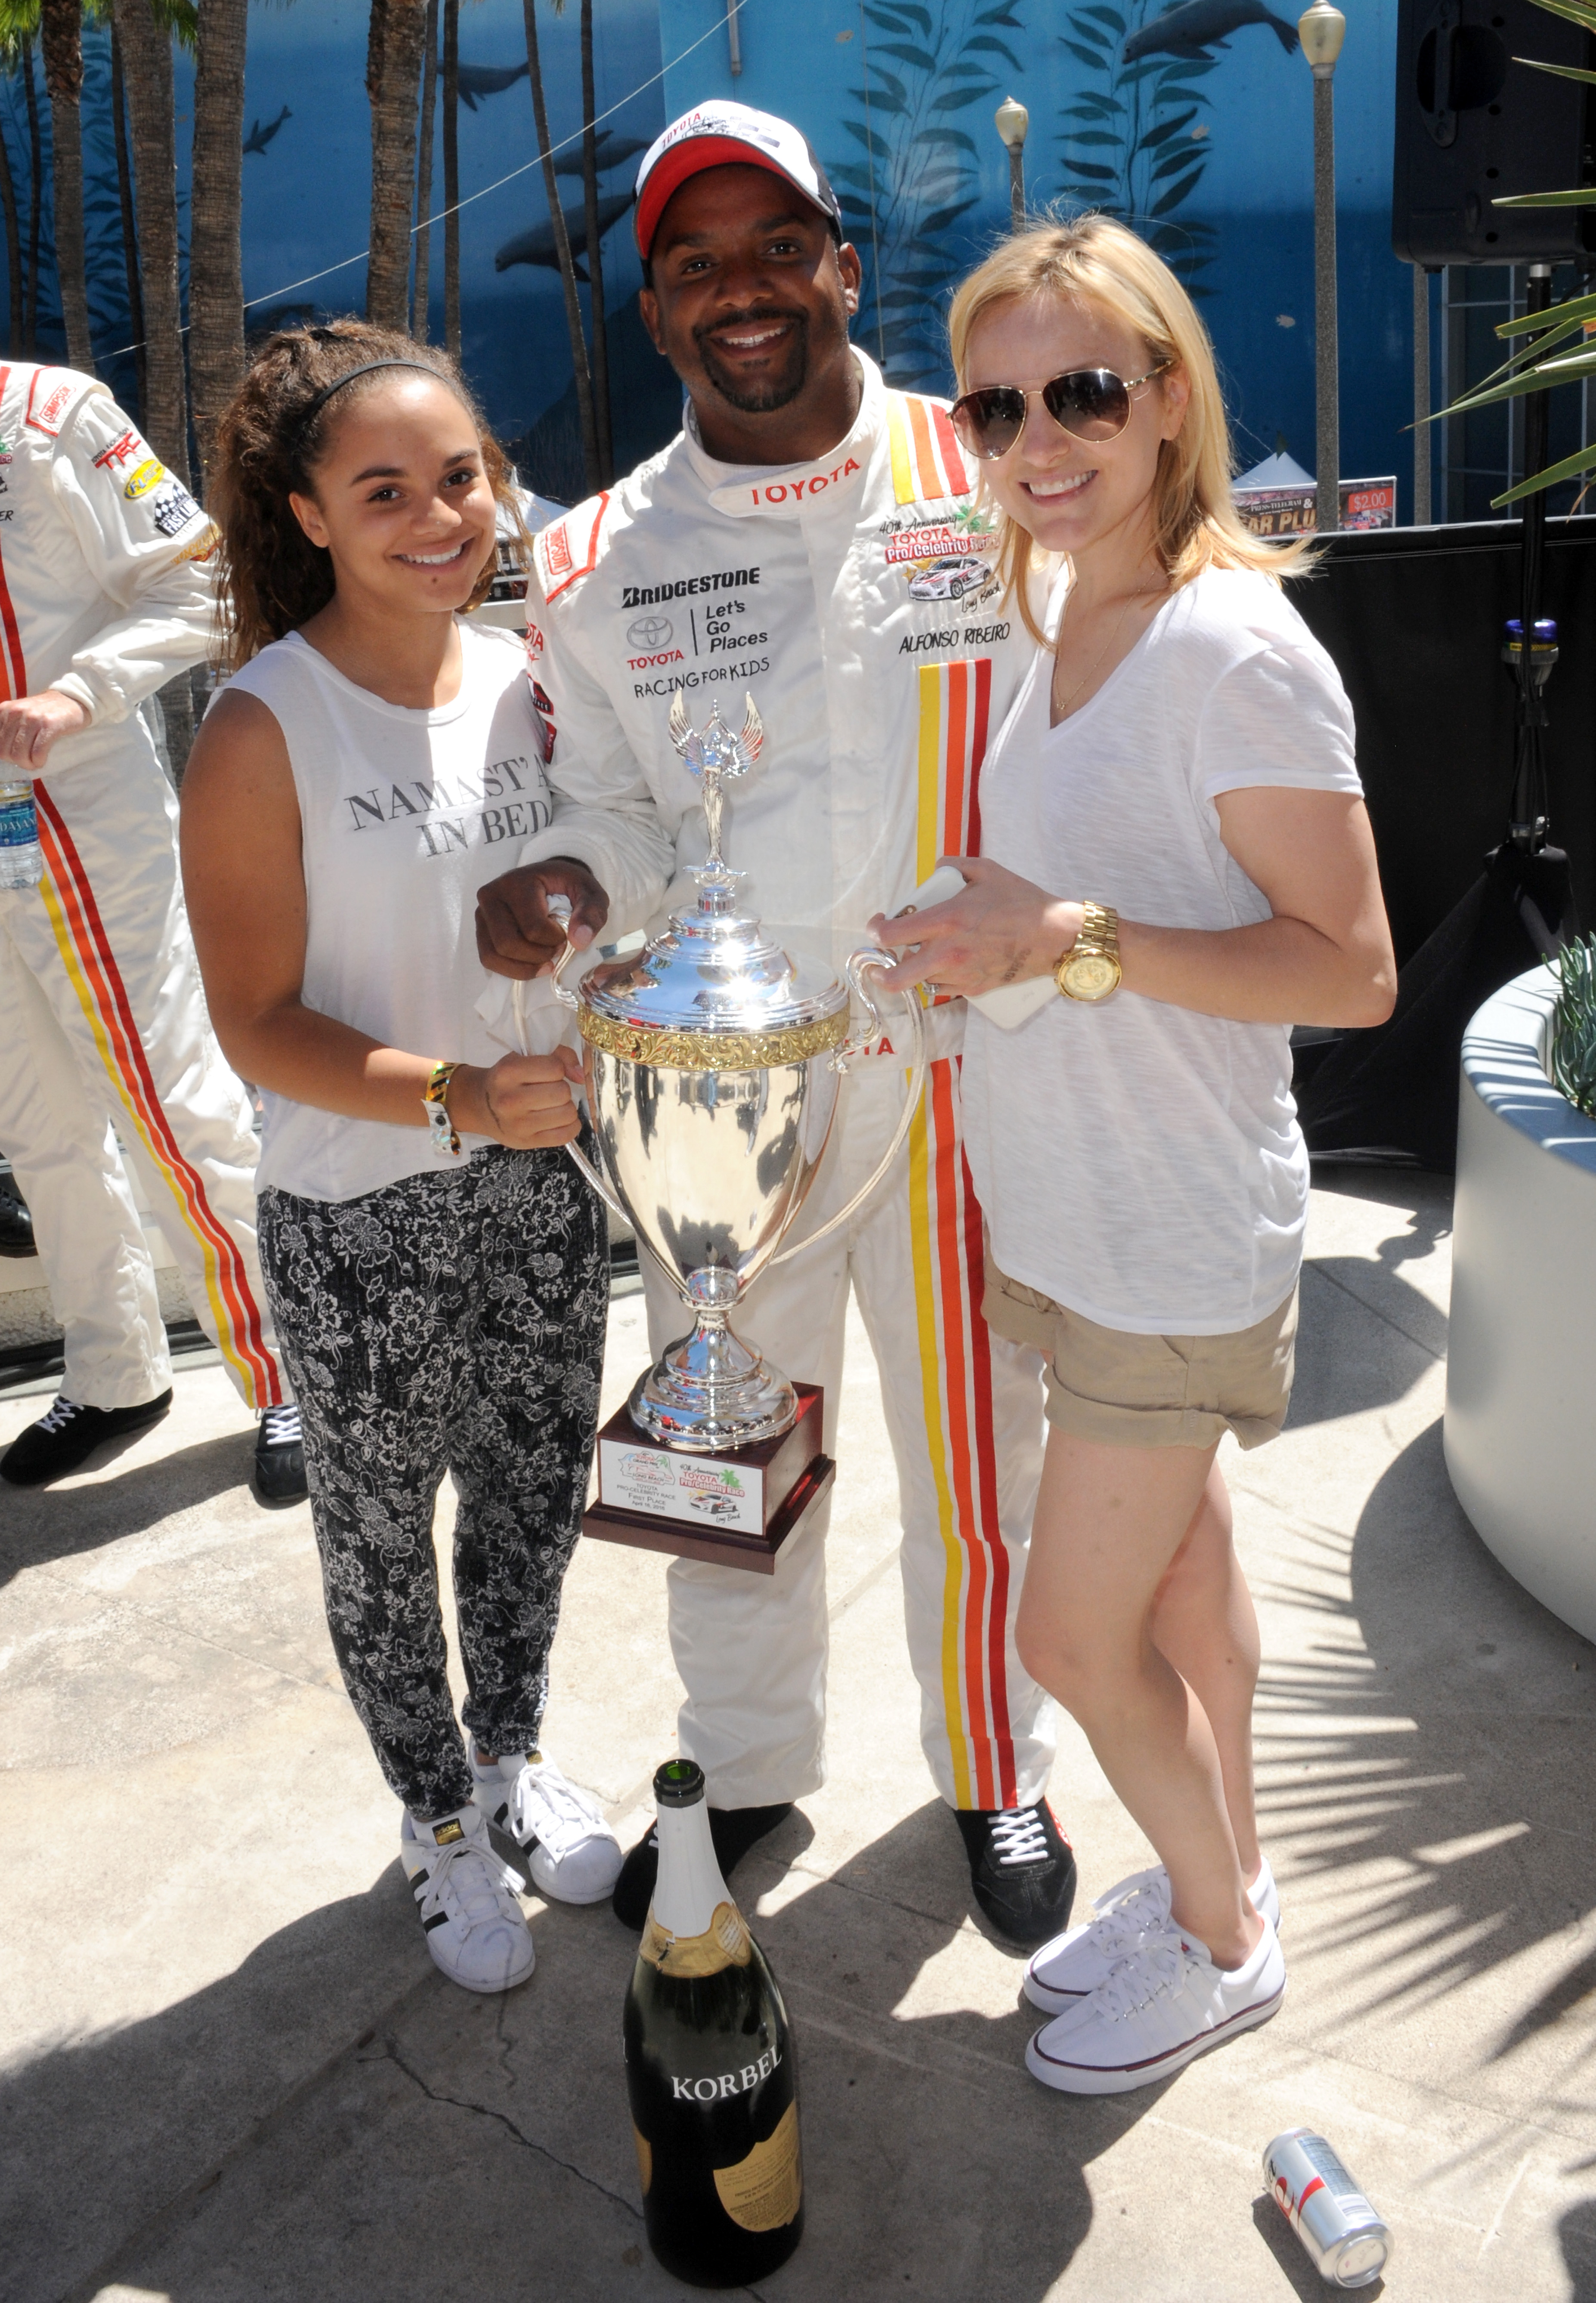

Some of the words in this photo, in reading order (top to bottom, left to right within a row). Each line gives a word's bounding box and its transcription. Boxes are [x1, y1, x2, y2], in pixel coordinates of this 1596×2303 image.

[662, 113, 701, 148] TOYOTA
[1303, 498, 1313, 509] &
[1354, 492, 1386, 512] $2.00
[163, 513, 187, 535] FAST
[1279, 509, 1316, 532] PLU
[889, 527, 951, 546] TOYOTA
[887, 539, 968, 561] Pro/Celebrity
[622, 567, 760, 608] BRIDGESTONE
[706, 600, 745, 619] Let's
[707, 621, 730, 635] Go
[899, 630, 959, 654] ALFONSO
[964, 622, 1010, 644] RIBEIRO
[710, 632, 768, 653] Places
[627, 649, 684, 670] TOYOTA
[416, 818, 468, 857] IN
[477, 800, 553, 844] BED
[684, 1471, 717, 1484] TOYOTA
[617, 1484, 659, 1496] PRO-CELEBRITY
[727, 1487, 744, 1496] Race
[671, 2045, 782, 2100] KORBEL
